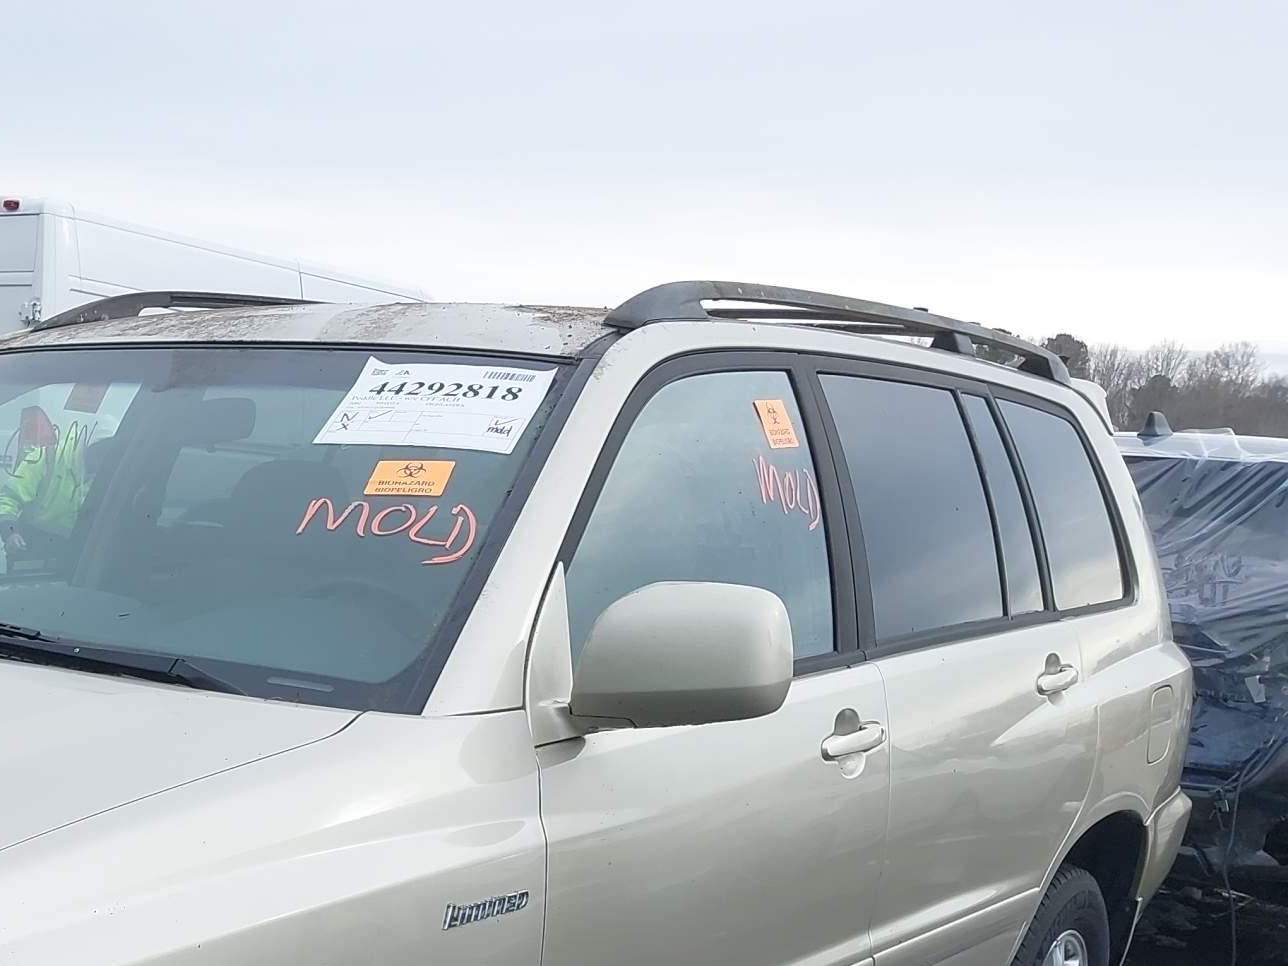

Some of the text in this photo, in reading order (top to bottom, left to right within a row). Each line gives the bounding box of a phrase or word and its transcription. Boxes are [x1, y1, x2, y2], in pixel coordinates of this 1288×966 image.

[368, 381, 523, 402] 44292818
[752, 455, 821, 531] MOLD
[296, 497, 478, 565] MOLD
